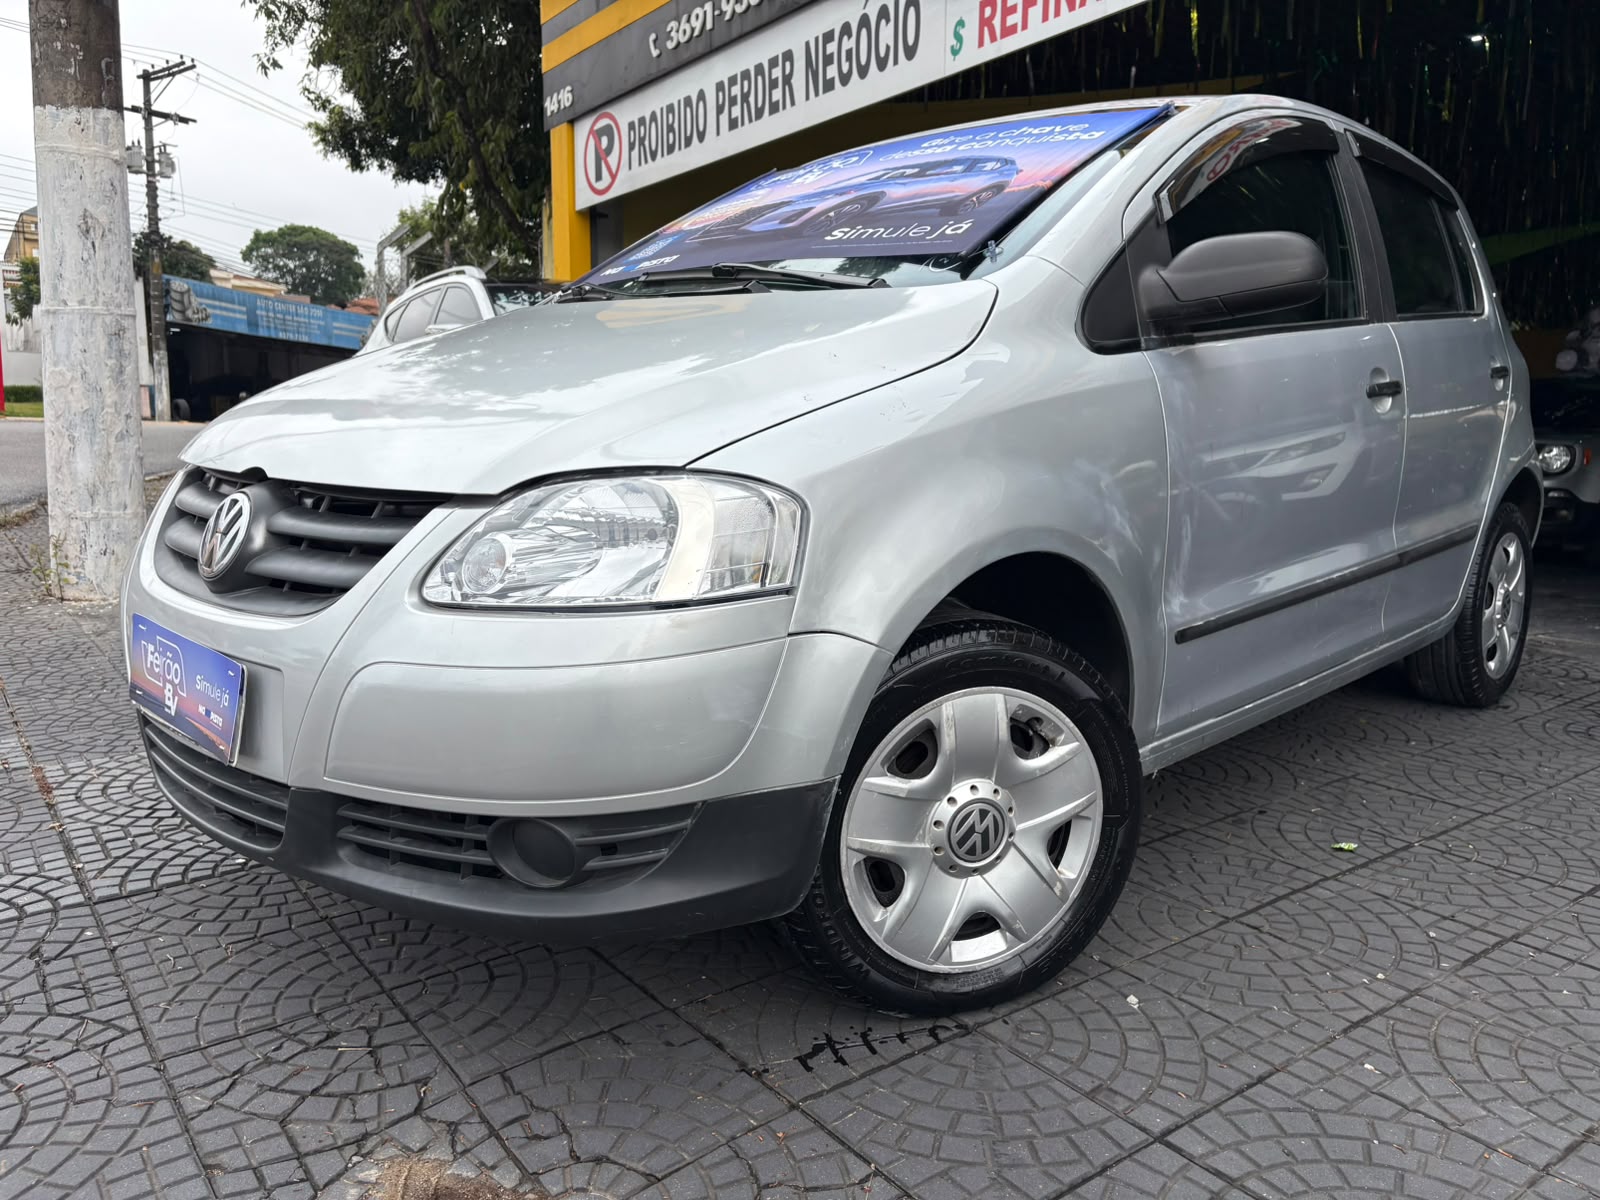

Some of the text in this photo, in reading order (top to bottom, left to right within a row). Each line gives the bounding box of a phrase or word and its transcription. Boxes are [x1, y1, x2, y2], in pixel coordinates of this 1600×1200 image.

[544, 84, 574, 117] 1416
[627, 0, 921, 171] PROIBIDO PERDER NEGÓCIO
[958, 130, 1105, 152] conquista
[998, 122, 1090, 138] chave
[925, 218, 975, 240] já
[147, 642, 181, 685] Feirão
[195, 672, 230, 708] Simule já
